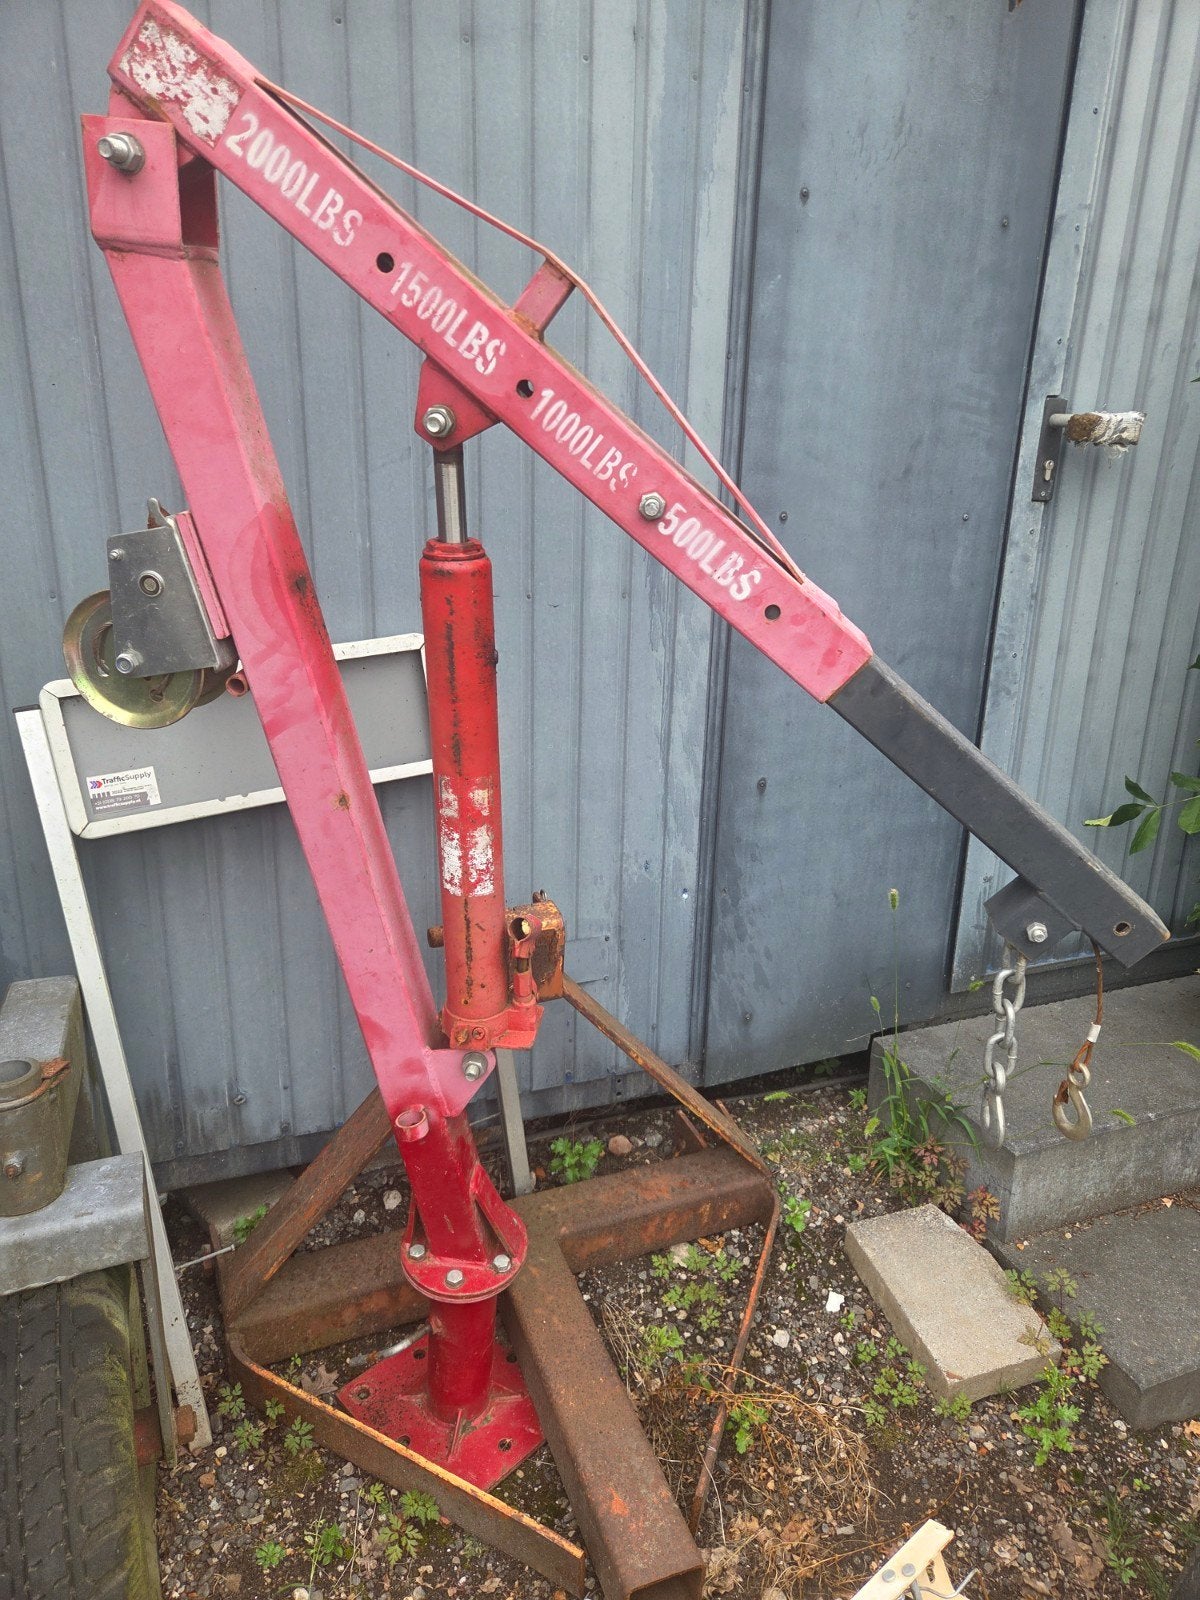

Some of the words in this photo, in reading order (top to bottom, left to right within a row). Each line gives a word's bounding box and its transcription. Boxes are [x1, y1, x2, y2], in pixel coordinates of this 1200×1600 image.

[225, 112, 363, 247] 2000LBS
[390, 261, 507, 375] 1500LBS
[530, 387, 638, 493] 1000LBS
[657, 502, 761, 601] 500LBS
[101, 771, 152, 785] TrafficSupply
